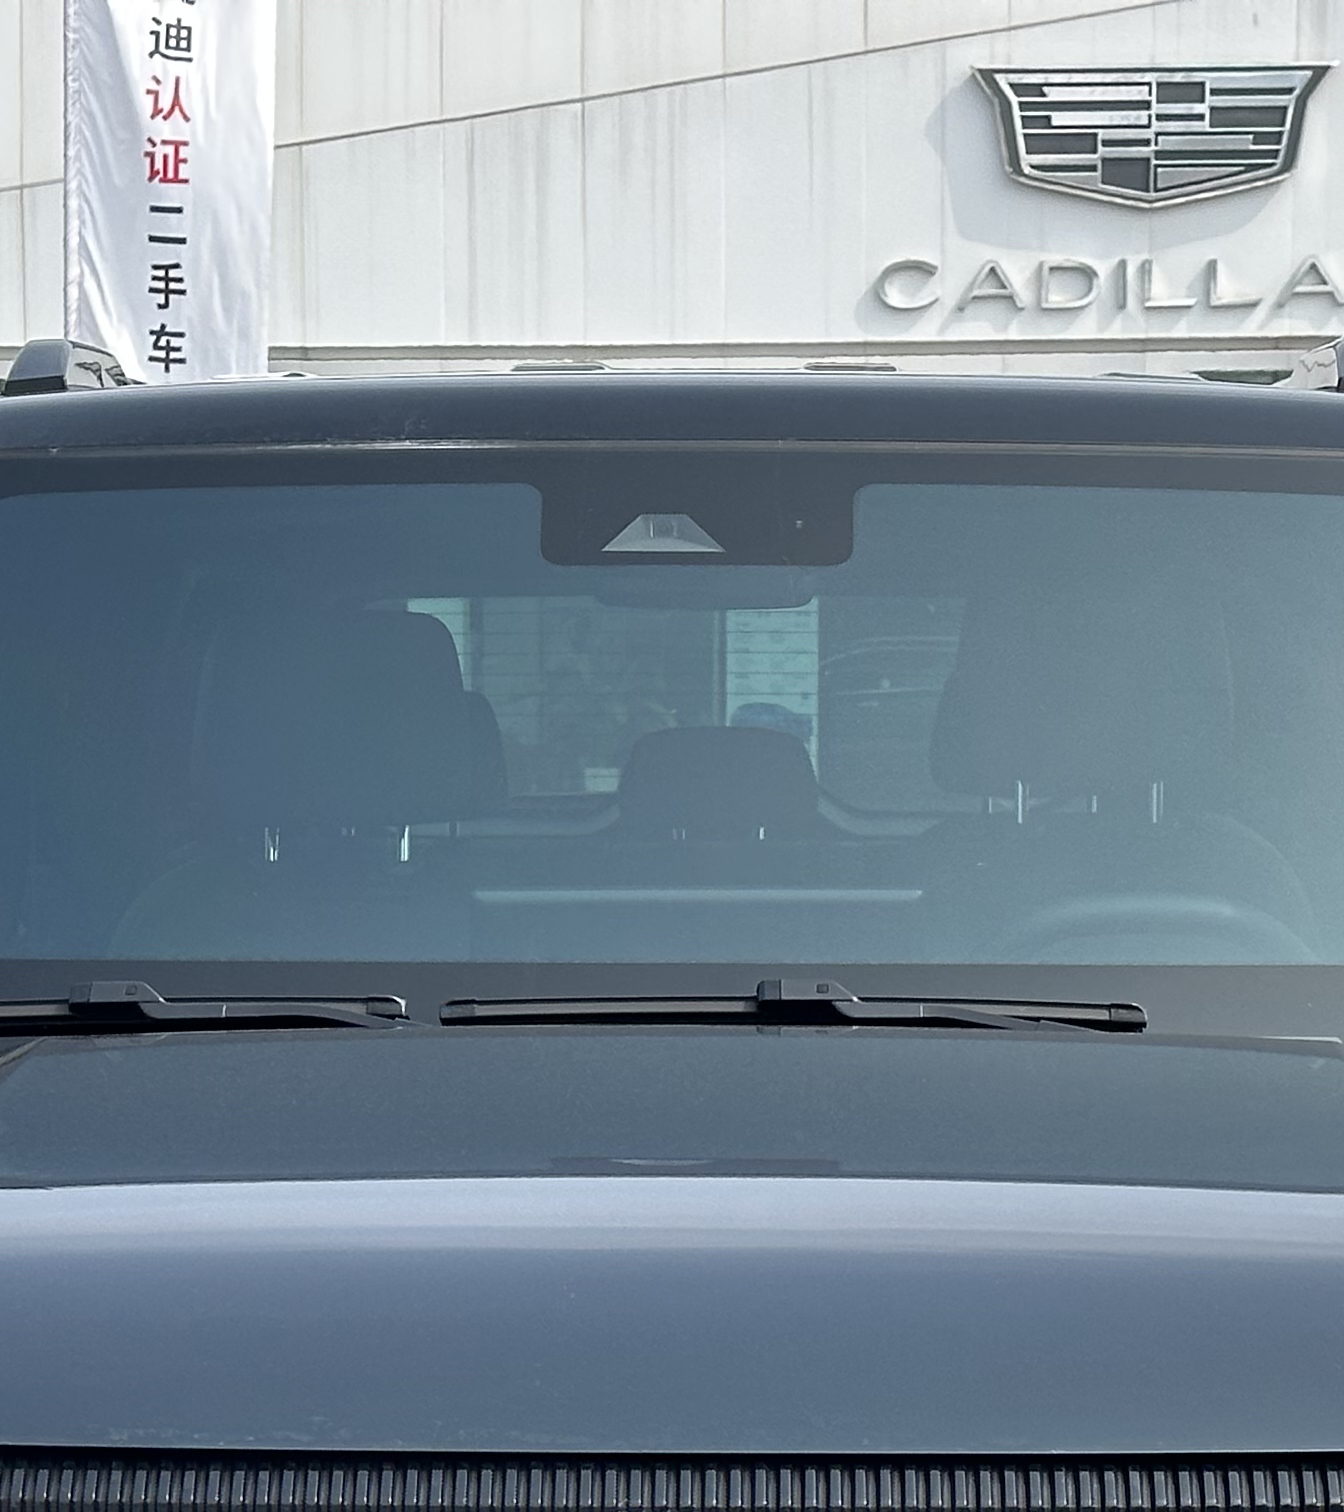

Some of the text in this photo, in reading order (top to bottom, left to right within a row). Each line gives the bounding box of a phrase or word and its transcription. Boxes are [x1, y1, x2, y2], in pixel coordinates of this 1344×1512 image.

[142, 0, 195, 374] 迪认证二手车
